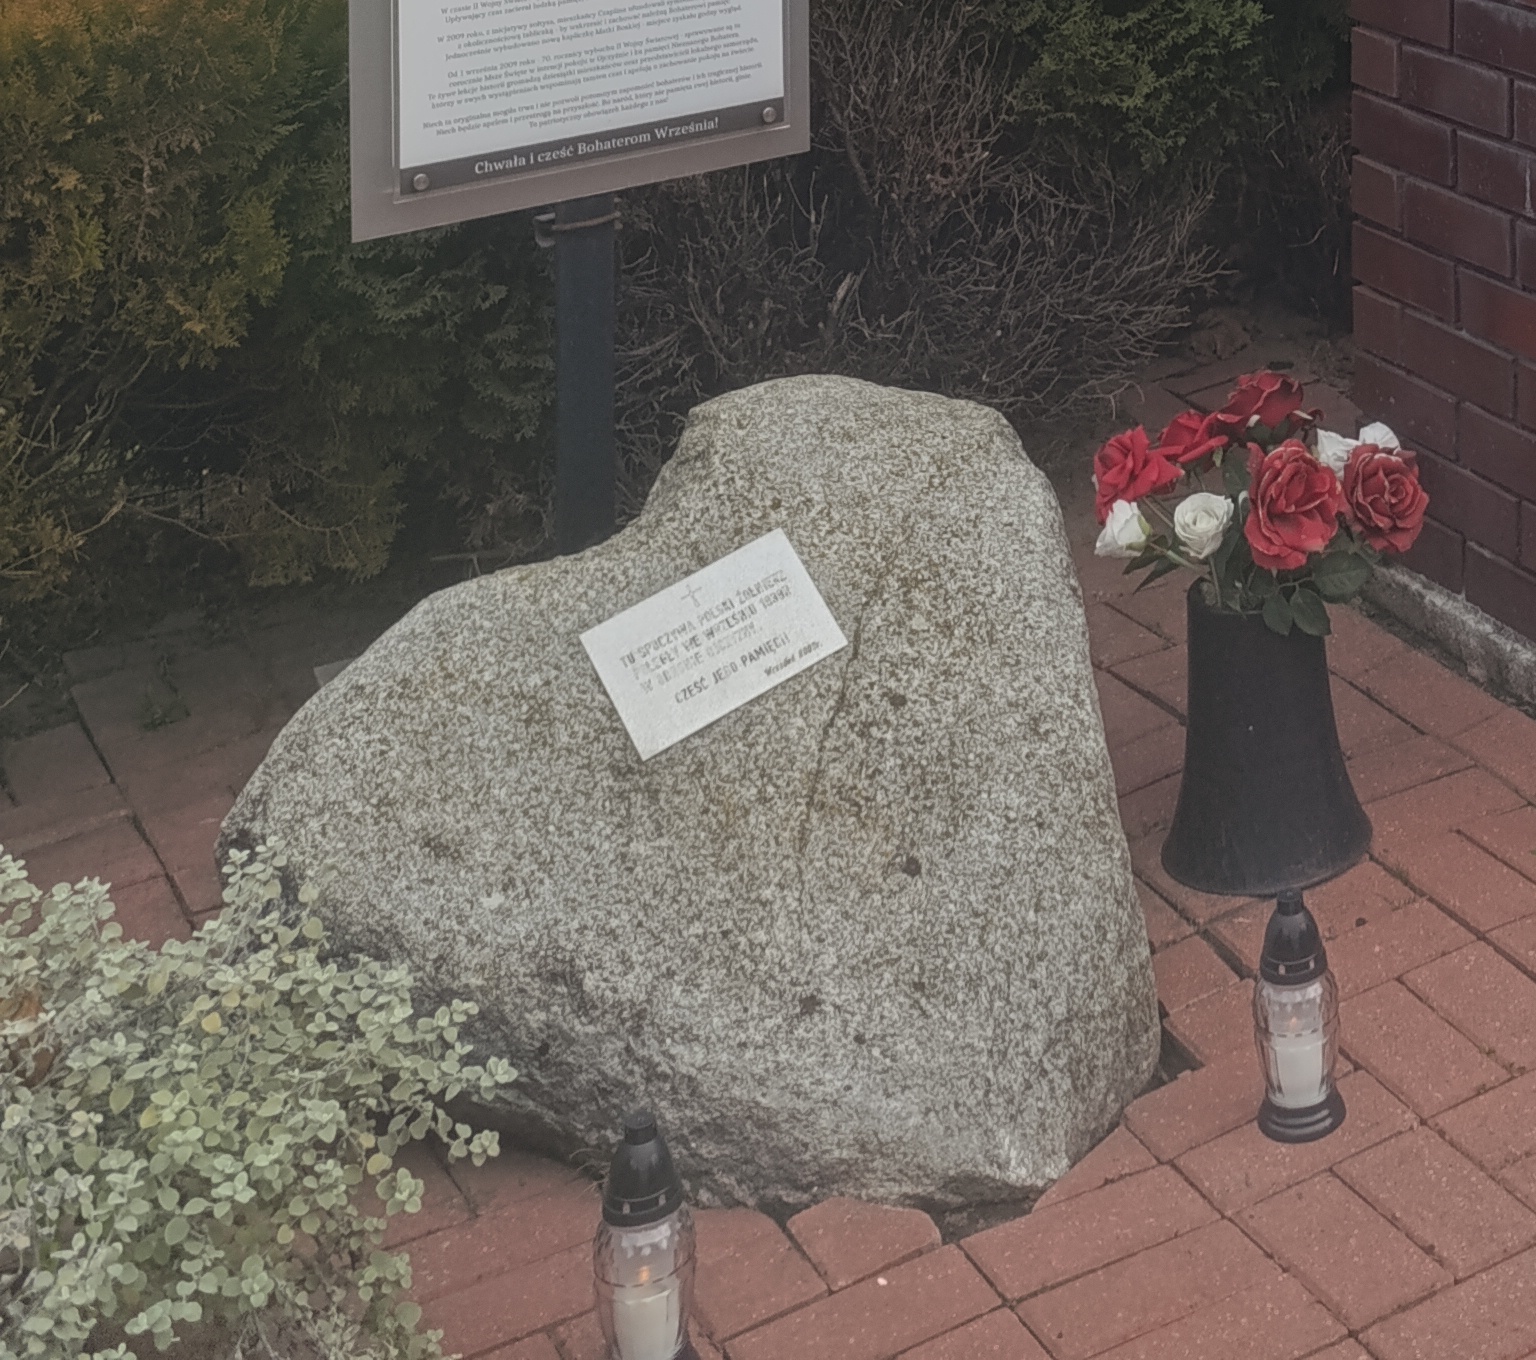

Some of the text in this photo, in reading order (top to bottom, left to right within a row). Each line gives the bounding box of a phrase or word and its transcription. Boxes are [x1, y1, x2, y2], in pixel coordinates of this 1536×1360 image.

[475, 117, 718, 174] Chwała i cześć Bohaterom Września!
